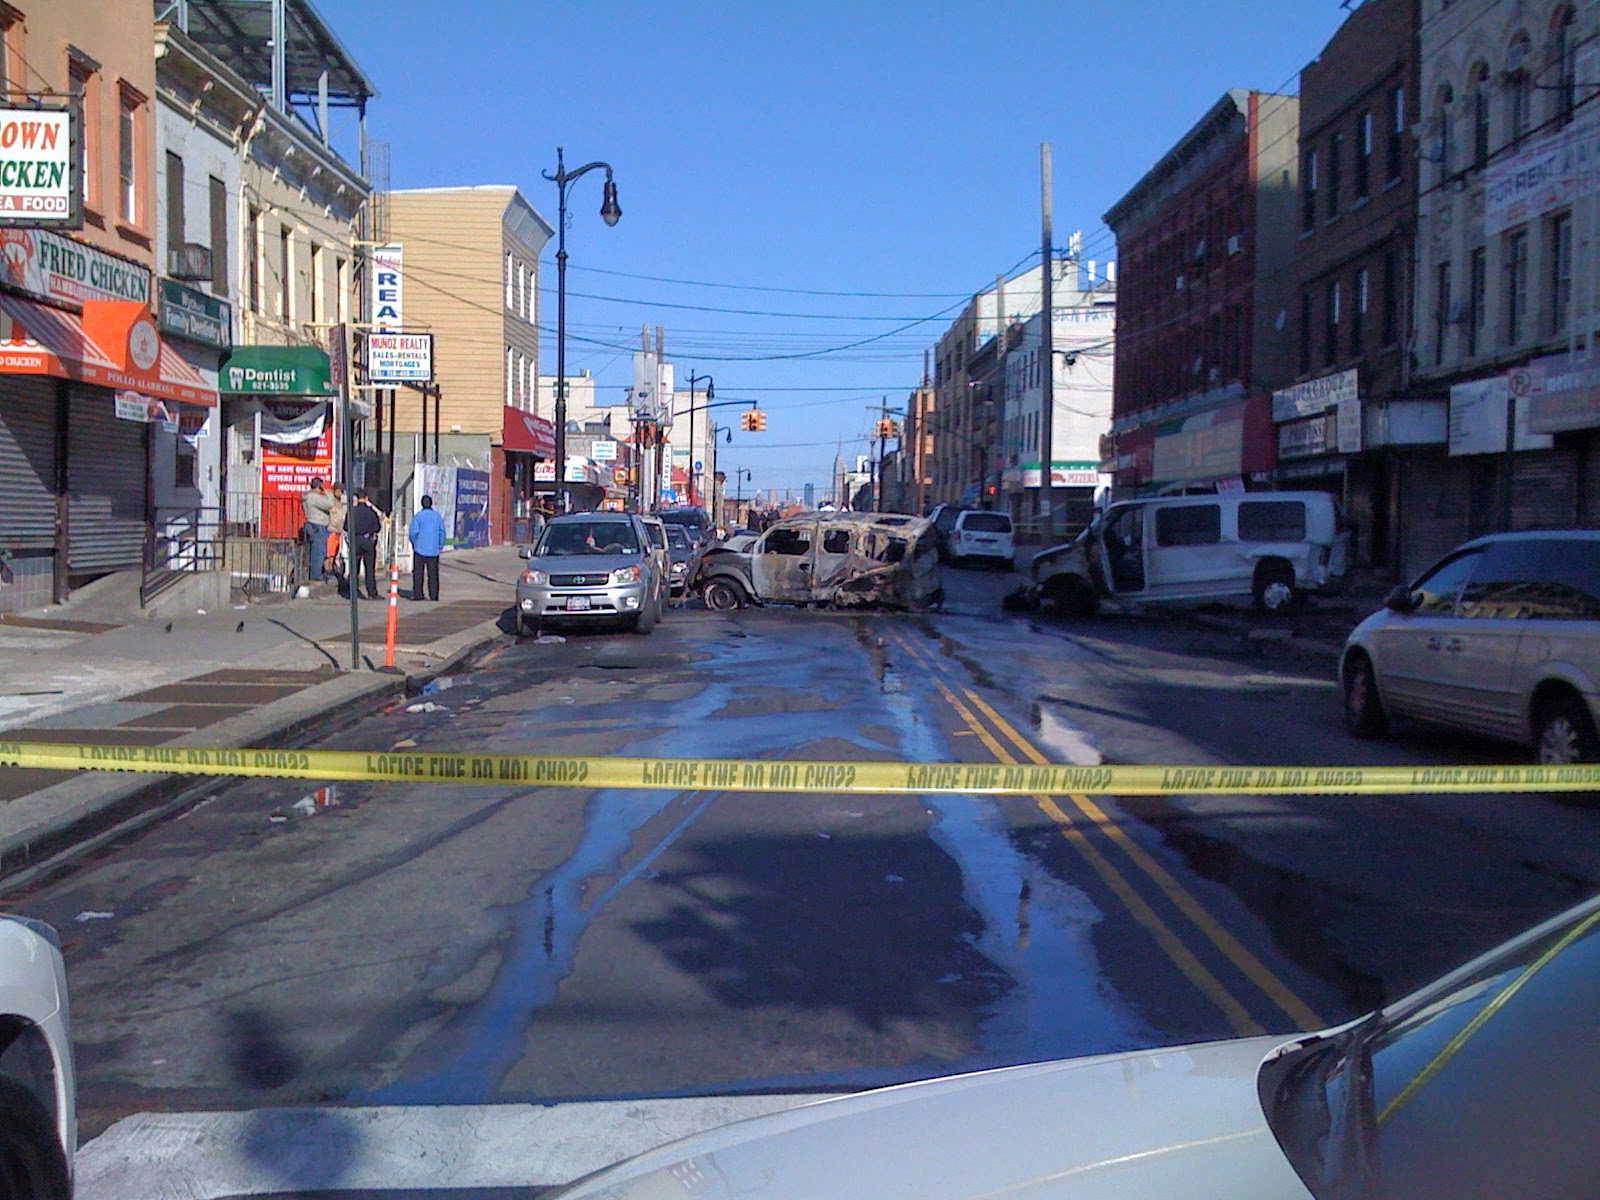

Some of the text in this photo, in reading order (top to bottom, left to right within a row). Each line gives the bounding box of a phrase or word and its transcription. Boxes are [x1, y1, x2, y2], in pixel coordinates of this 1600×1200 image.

[0, 121, 60, 149] OWN
[22, 197, 66, 211] FOOD
[39, 239, 147, 302] FRIED CHICKEN
[400, 338, 428, 350] REALTY
[106, 372, 135, 386] POLLO
[245, 368, 296, 383] Dentist
[266, 465, 277, 473] WE
[277, 465, 294, 473] HAVE
[294, 475, 307, 483] FOR
